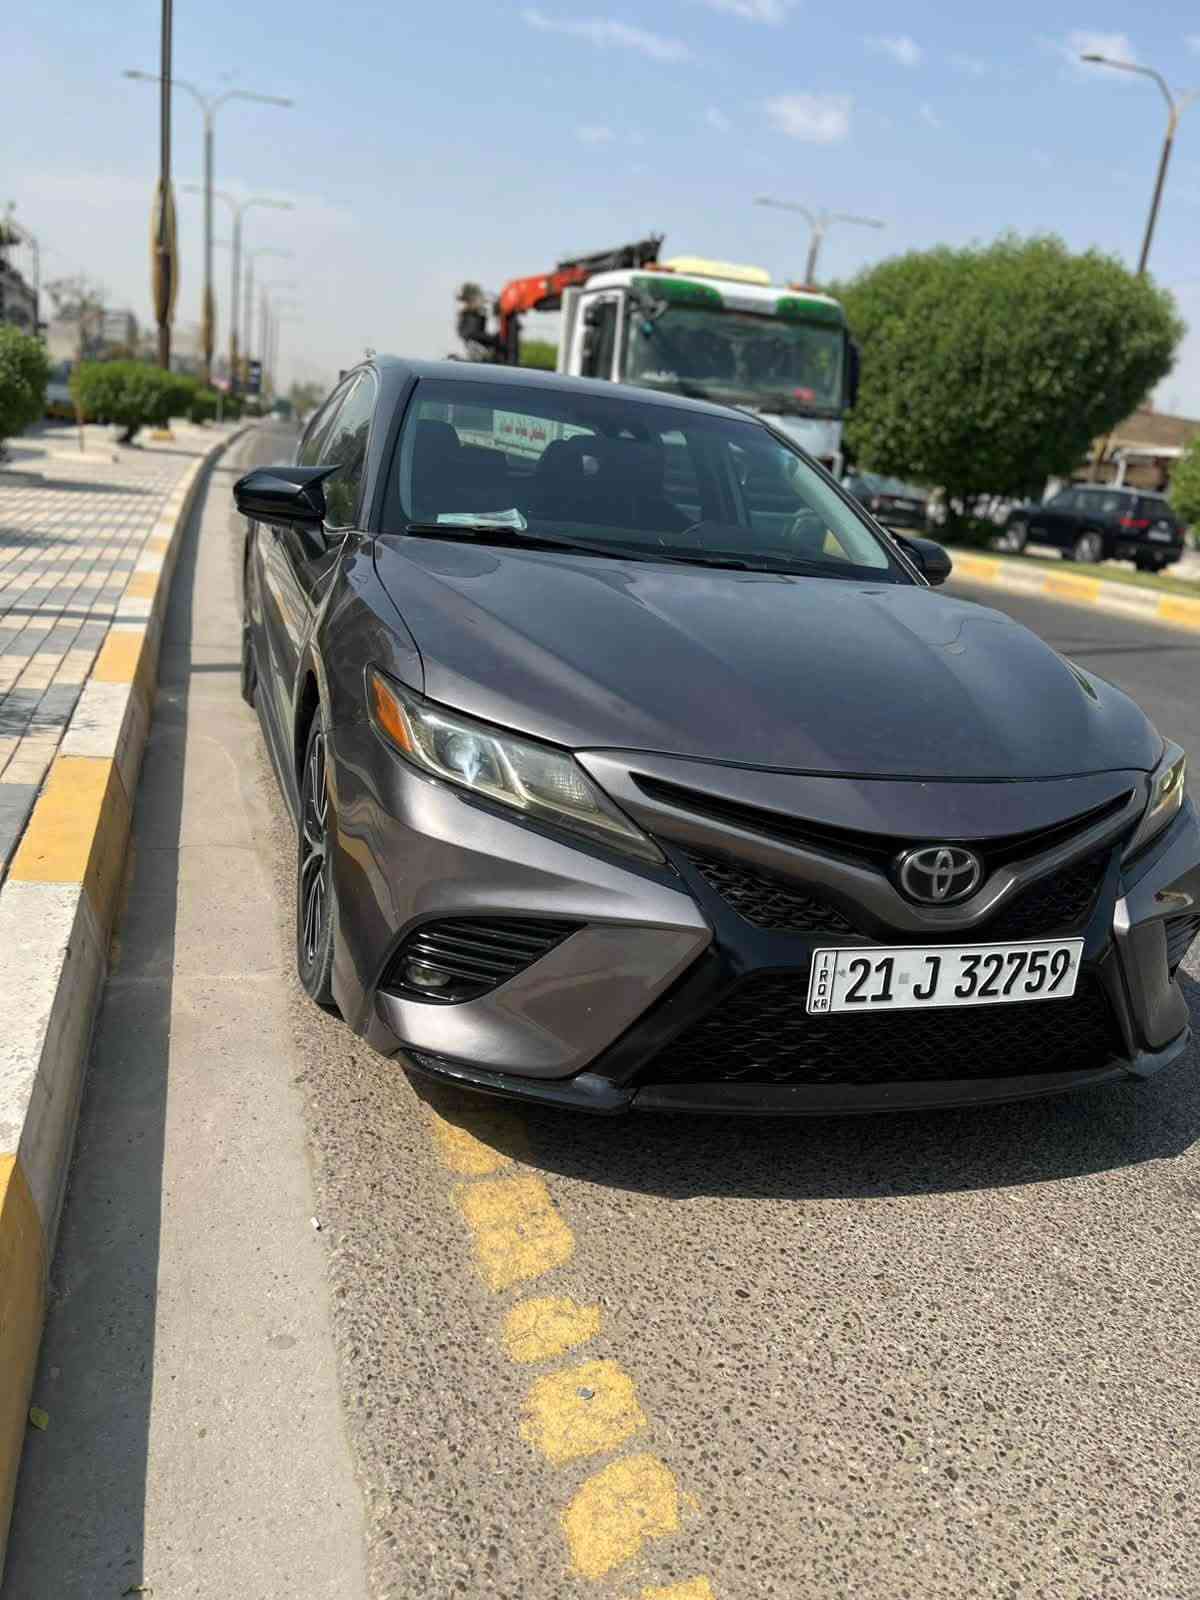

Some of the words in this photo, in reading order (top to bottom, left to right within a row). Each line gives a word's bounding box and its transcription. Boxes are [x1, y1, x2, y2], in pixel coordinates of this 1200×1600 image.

[845, 957, 895, 1002] 21
[913, 956, 941, 1000] J
[954, 949, 1071, 998] 32759
[813, 998, 828, 1009] KR
